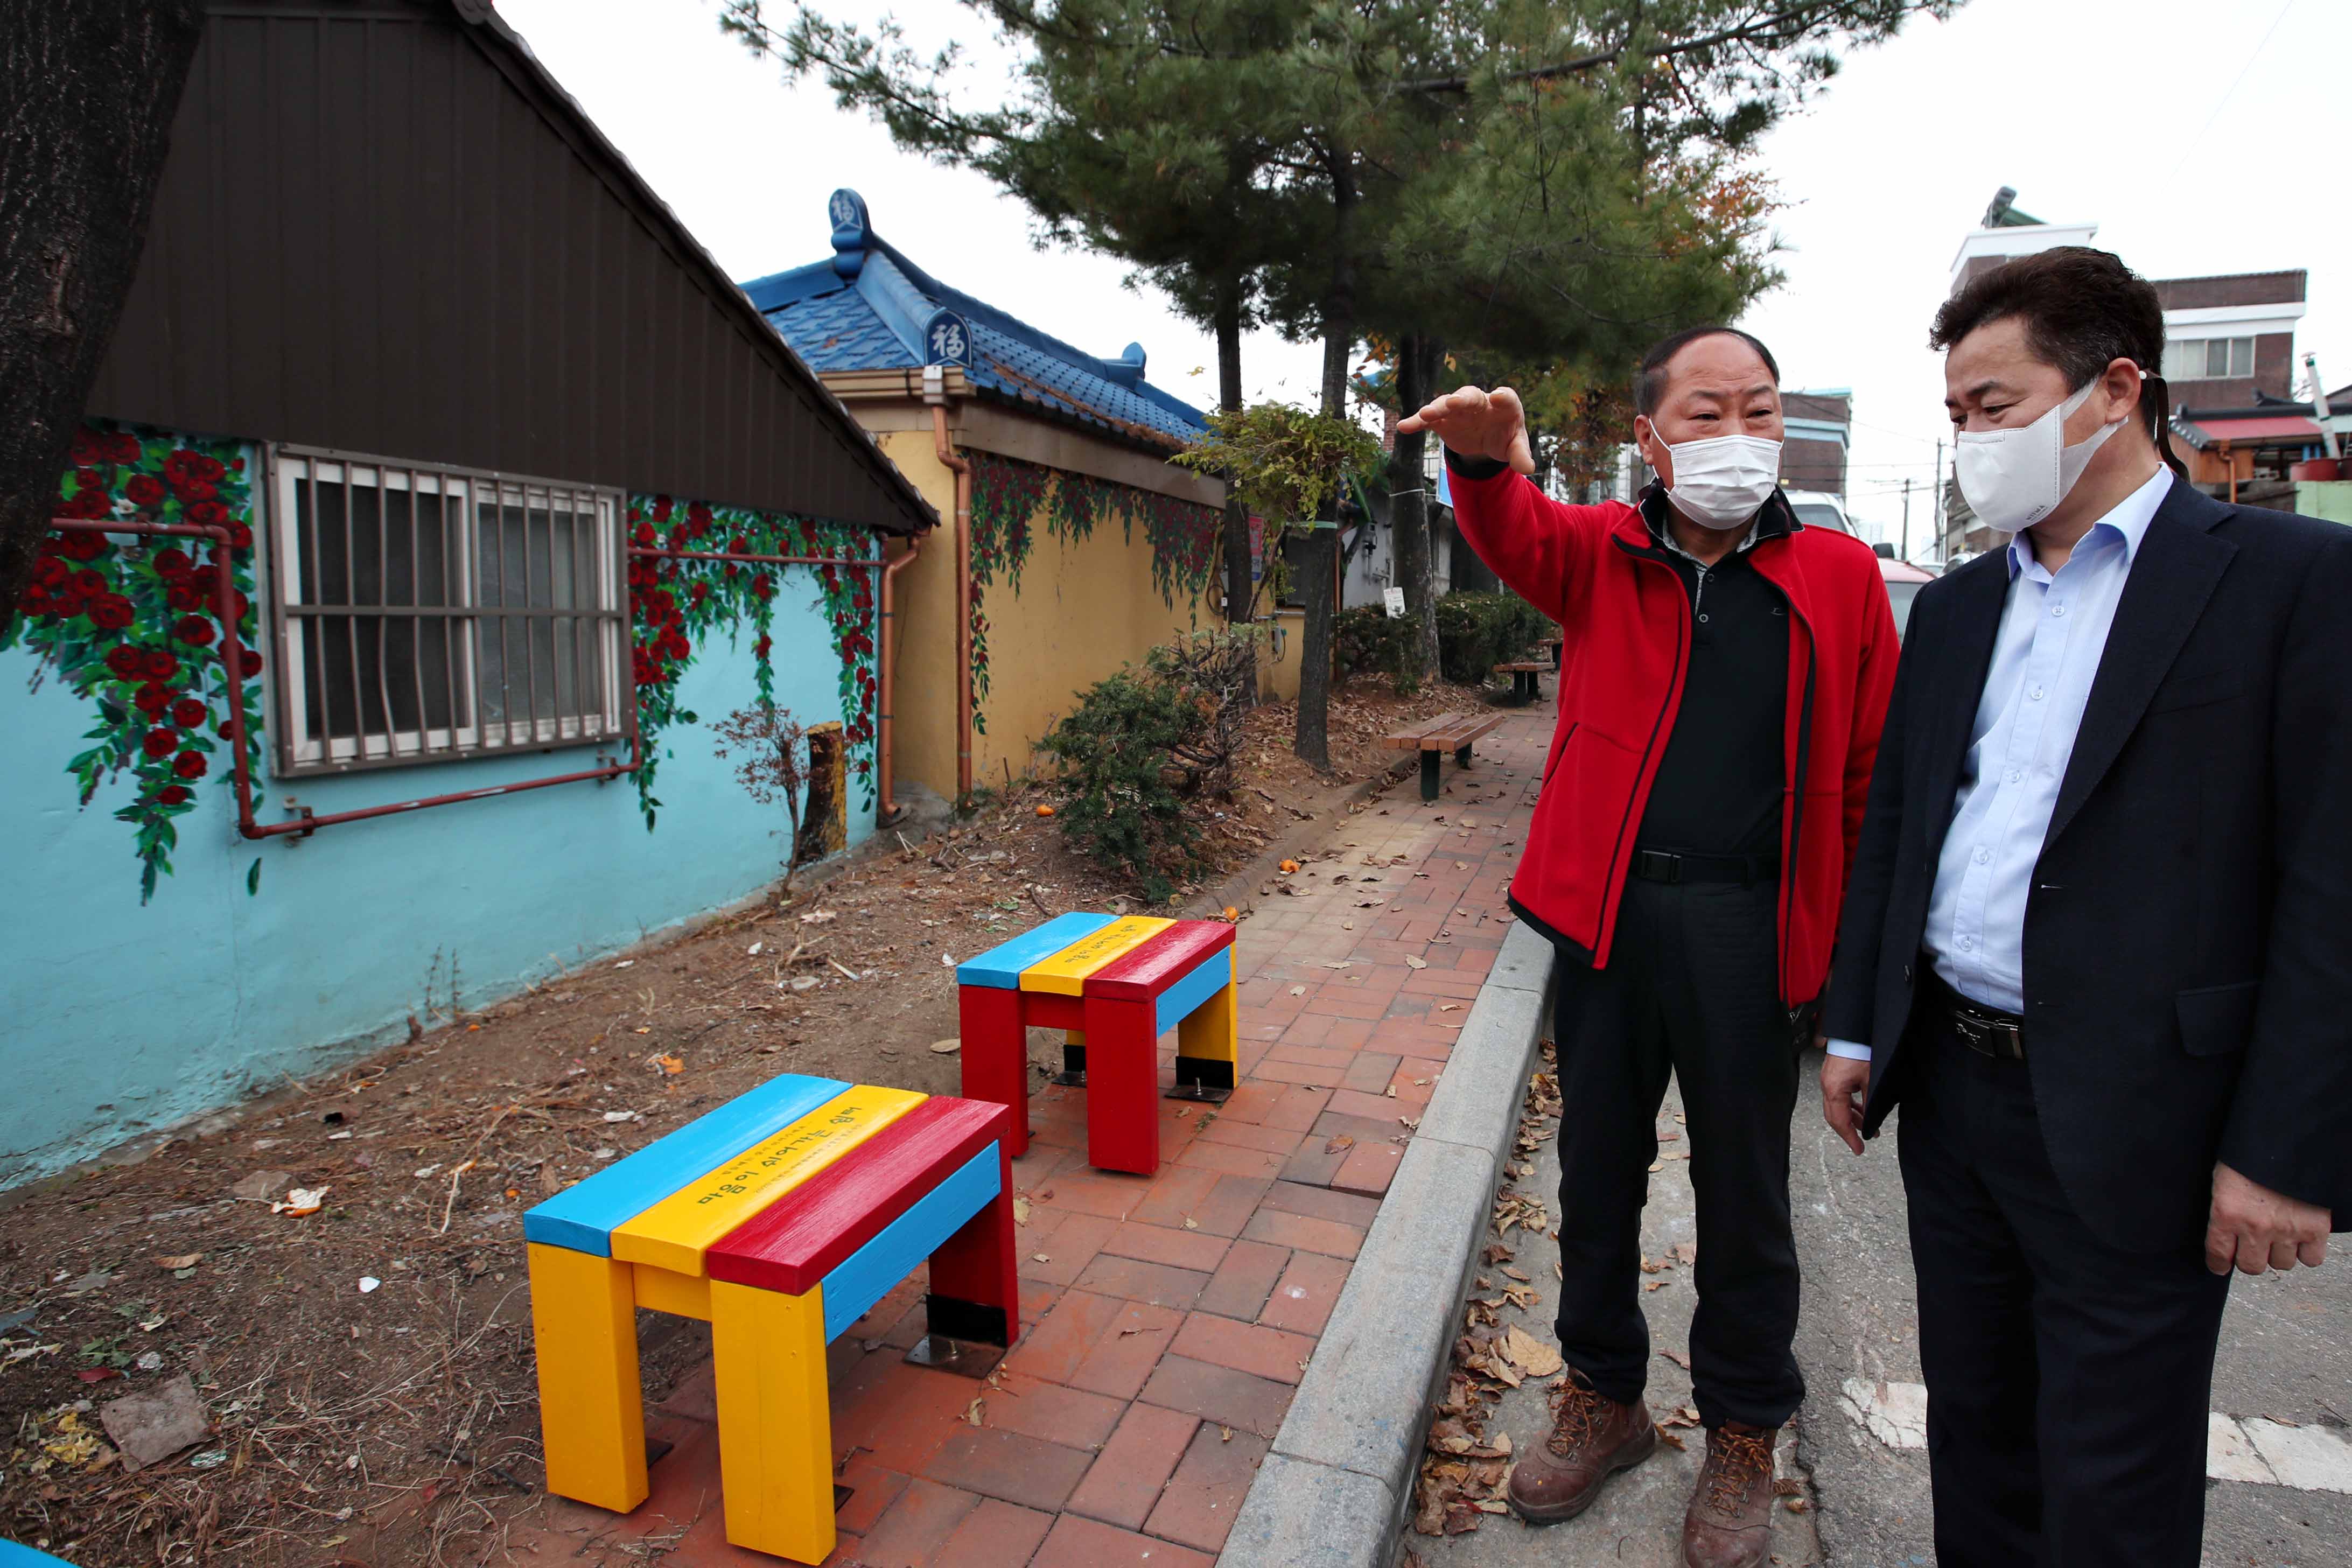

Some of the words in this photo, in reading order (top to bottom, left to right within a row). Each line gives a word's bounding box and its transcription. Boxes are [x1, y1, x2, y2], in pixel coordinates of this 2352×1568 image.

[932, 324, 965, 358] 福
[697, 1171, 759, 1205] 마음이
[761, 1129, 833, 1167] 쉬어가는
[829, 1107, 862, 1124] 쉼터
